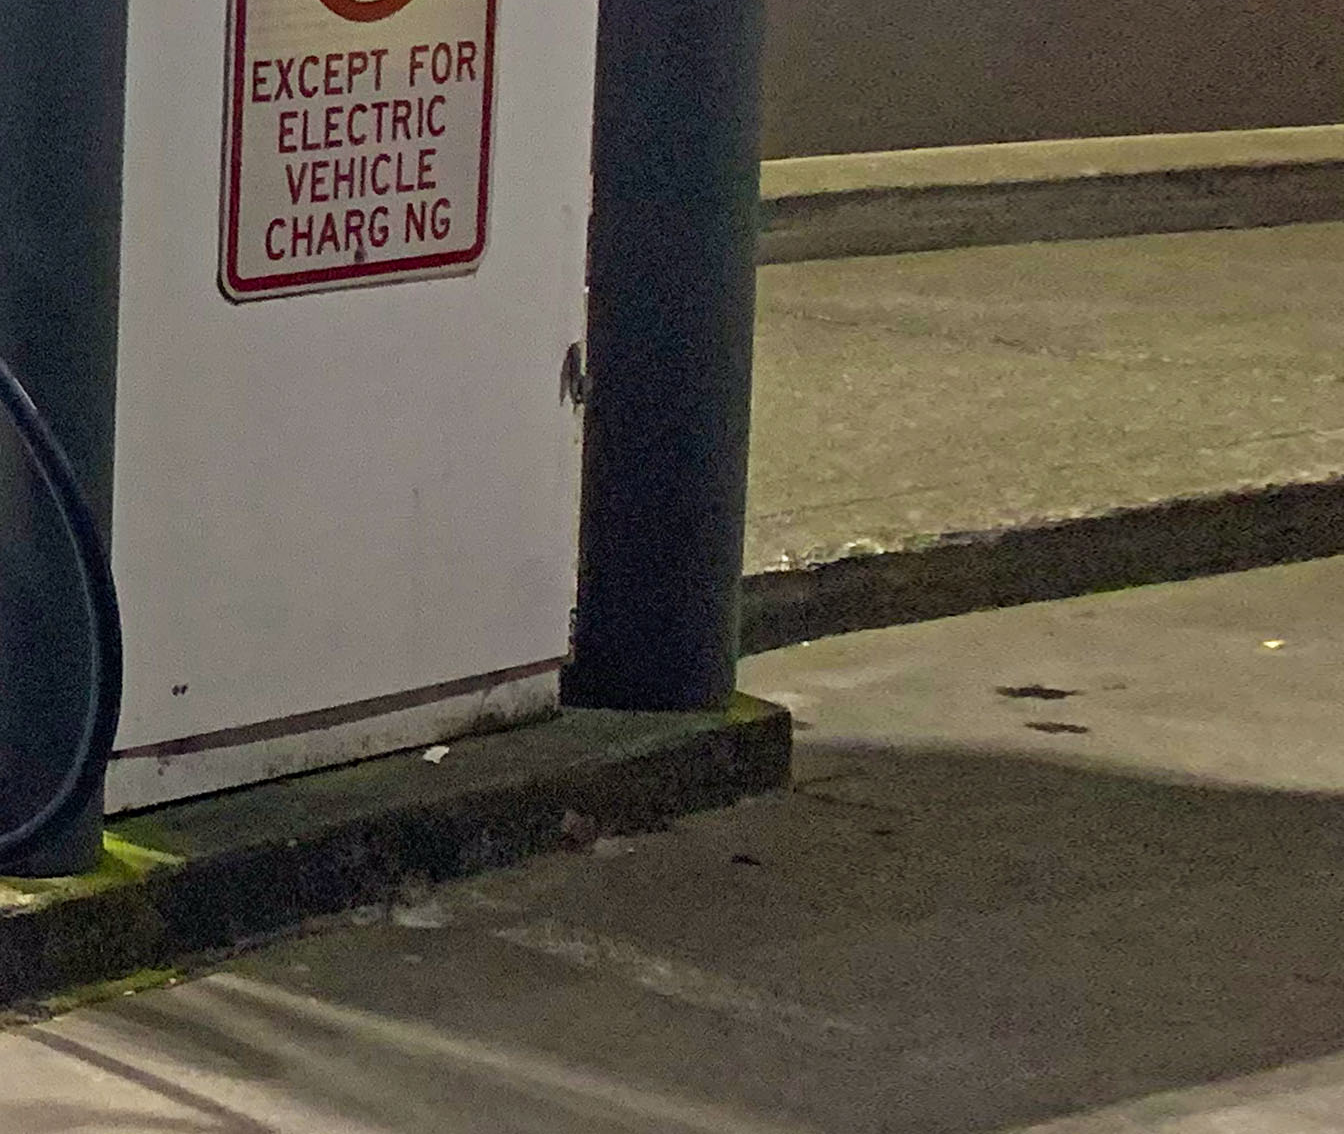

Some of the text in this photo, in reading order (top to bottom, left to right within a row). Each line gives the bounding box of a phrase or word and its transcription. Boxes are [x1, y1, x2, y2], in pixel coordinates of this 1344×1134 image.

[251, 40, 477, 103] EXCEPT FOR
[278, 94, 446, 154] ELECTRIC
[285, 148, 437, 205] VEHICLE
[264, 197, 451, 261] CHARGNG
